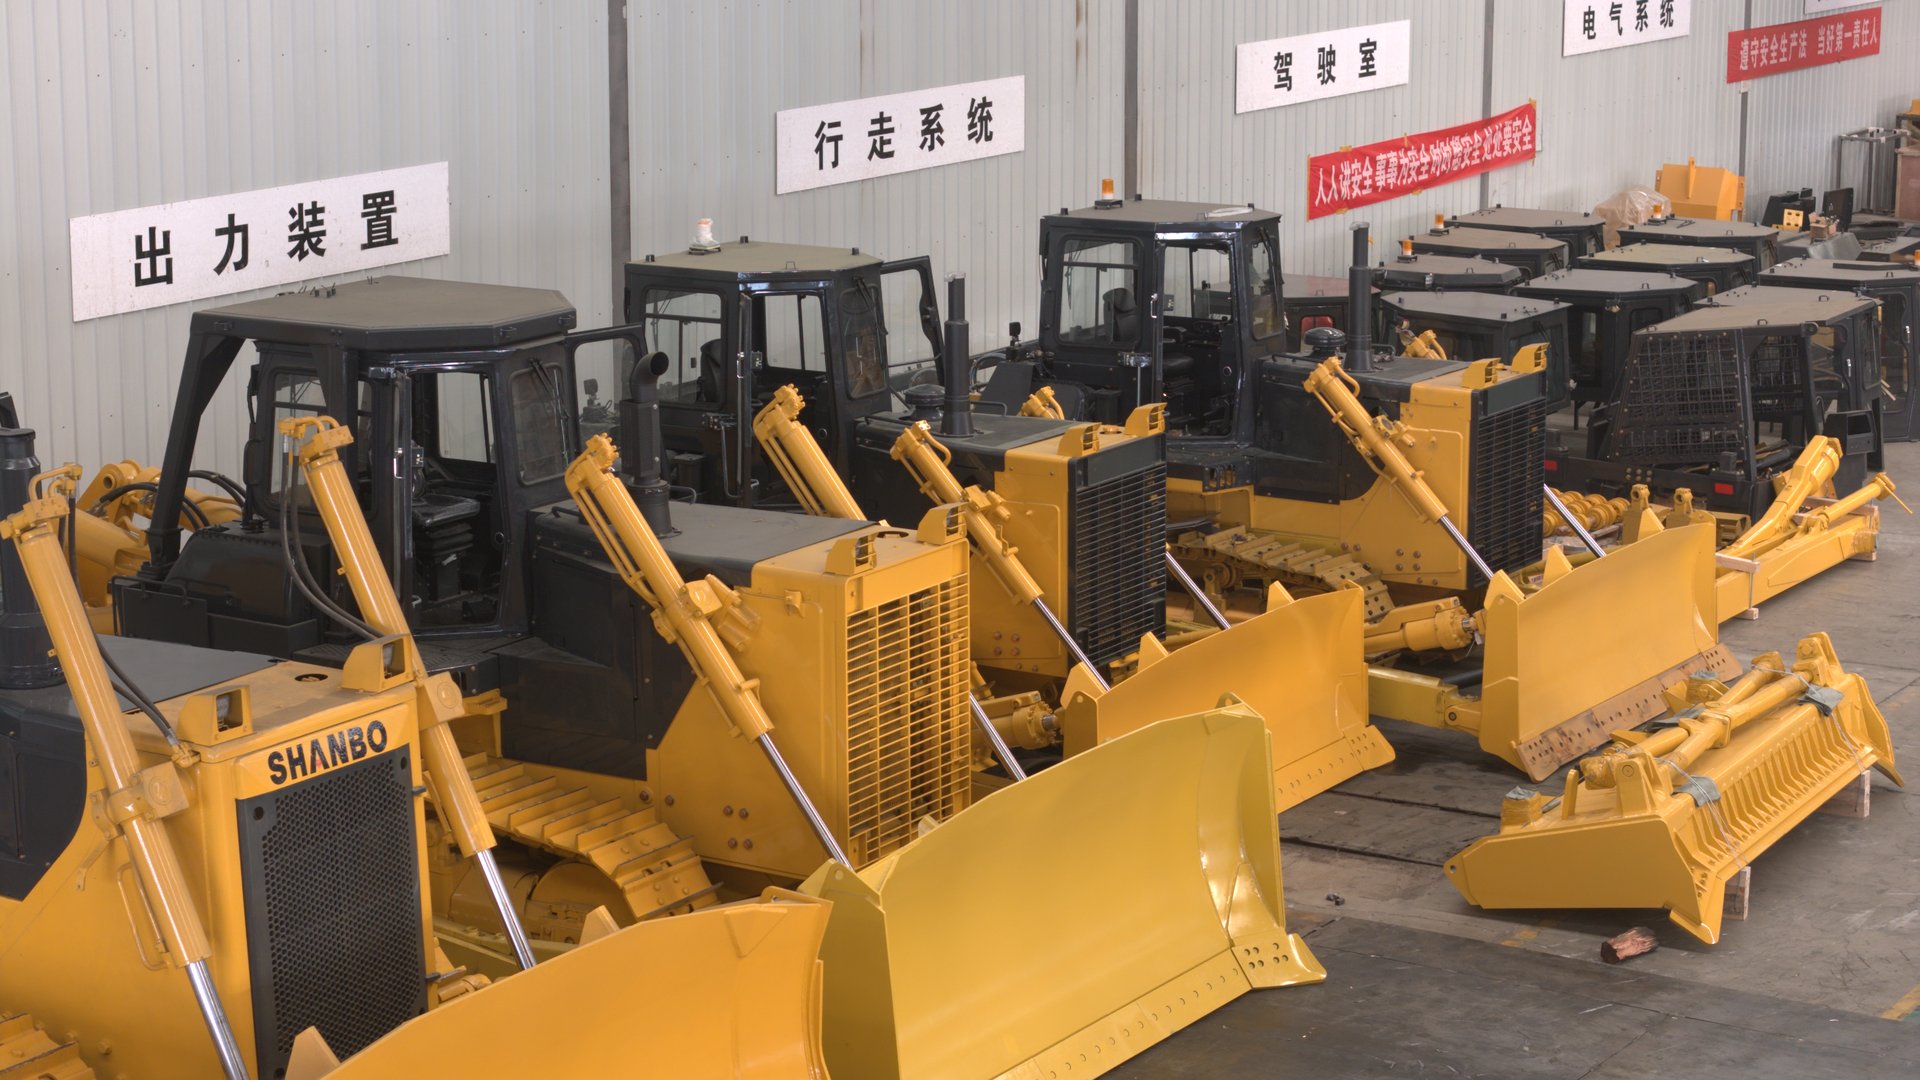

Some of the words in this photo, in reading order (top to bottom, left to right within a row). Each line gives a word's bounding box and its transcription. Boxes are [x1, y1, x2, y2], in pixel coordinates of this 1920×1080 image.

[1583, 0, 1674, 40] 电气系统
[1274, 38, 1377, 91] 驾驶室
[814, 96, 993, 170] 行走系统
[134, 190, 399, 287] 出力装置
[268, 720, 387, 785] SHANBO
